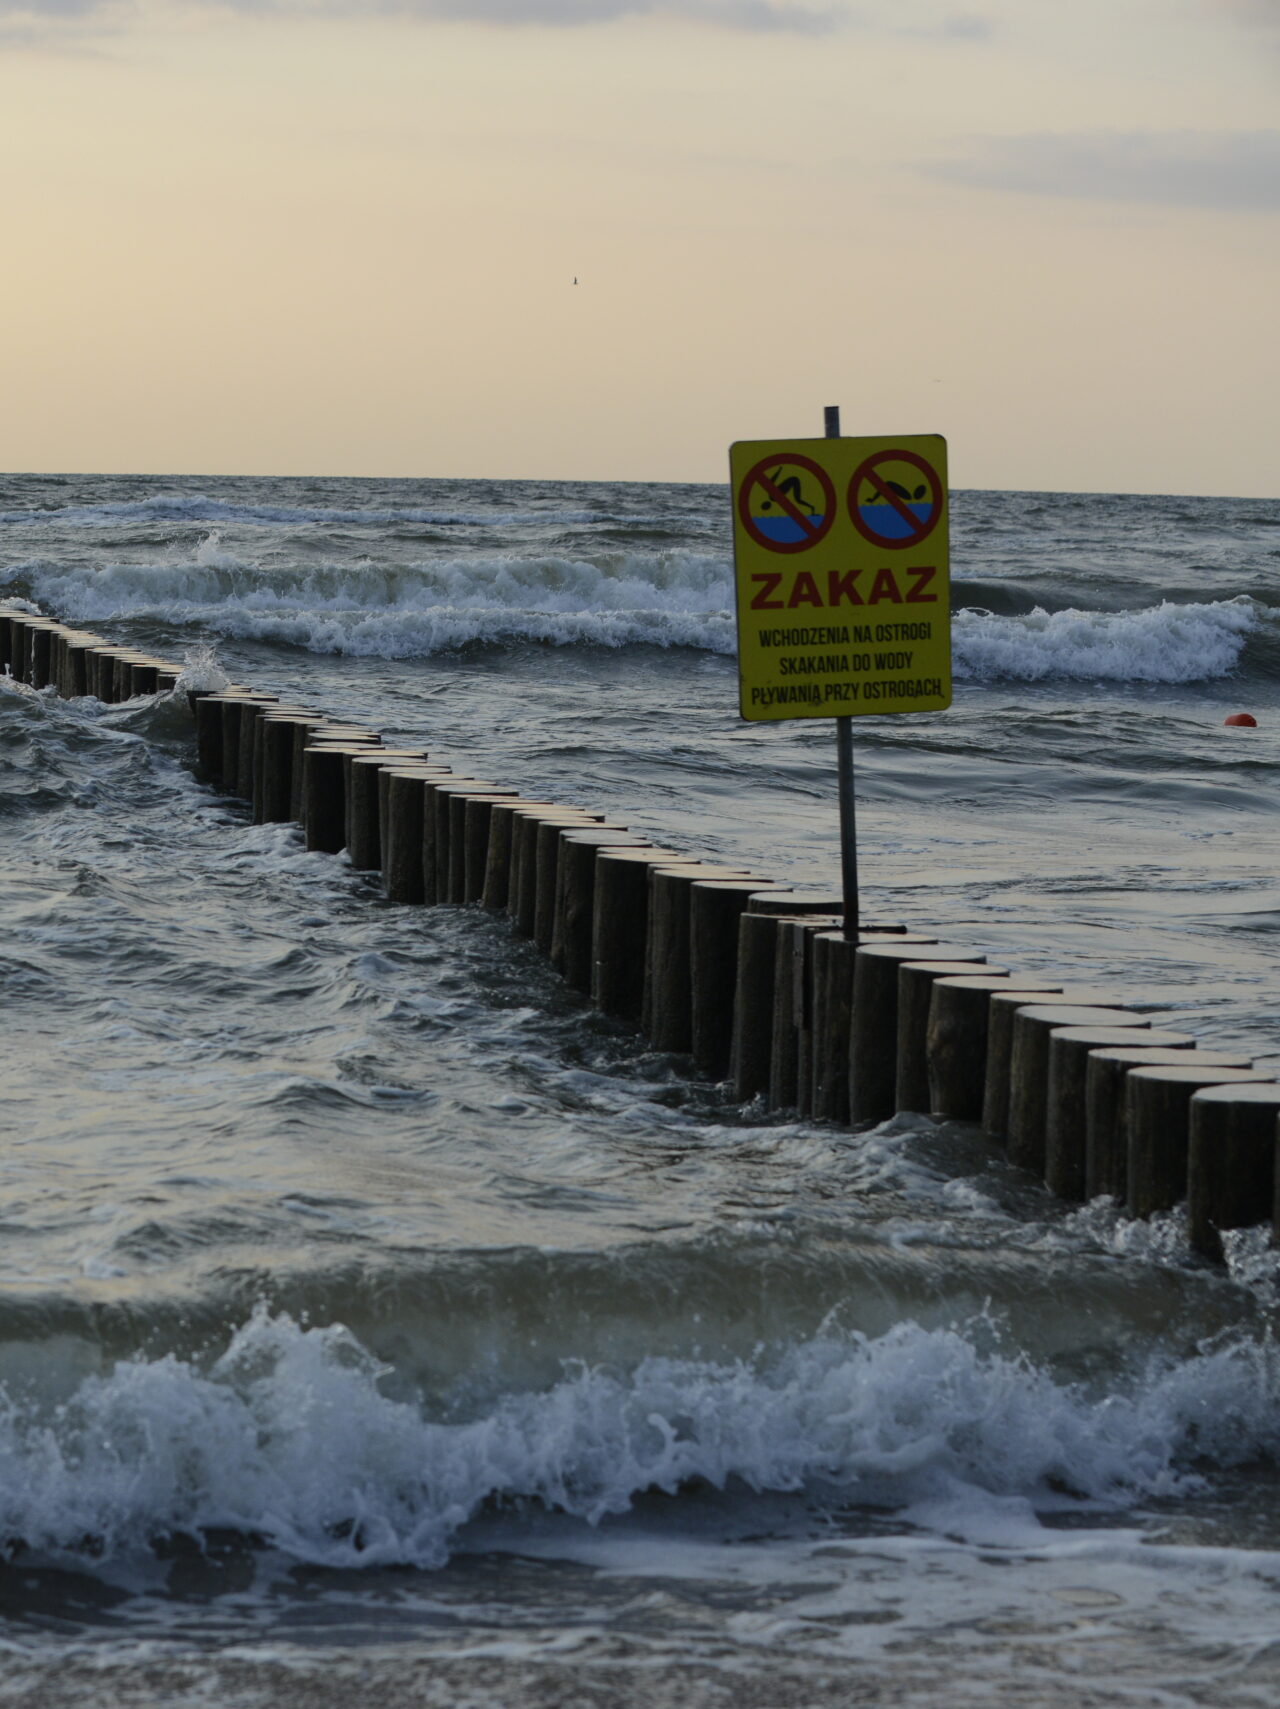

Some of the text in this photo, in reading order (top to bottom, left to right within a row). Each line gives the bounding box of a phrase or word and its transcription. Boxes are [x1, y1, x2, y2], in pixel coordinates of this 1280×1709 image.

[750, 566, 938, 610] ZAKAZ
[759, 622, 932, 647] WCHODZENIA NA OSTROGI
[780, 652, 913, 675] SKAKANIA DO WODY
[751, 678, 942, 705] PŁYWANIA PRZY OSTROGACH
